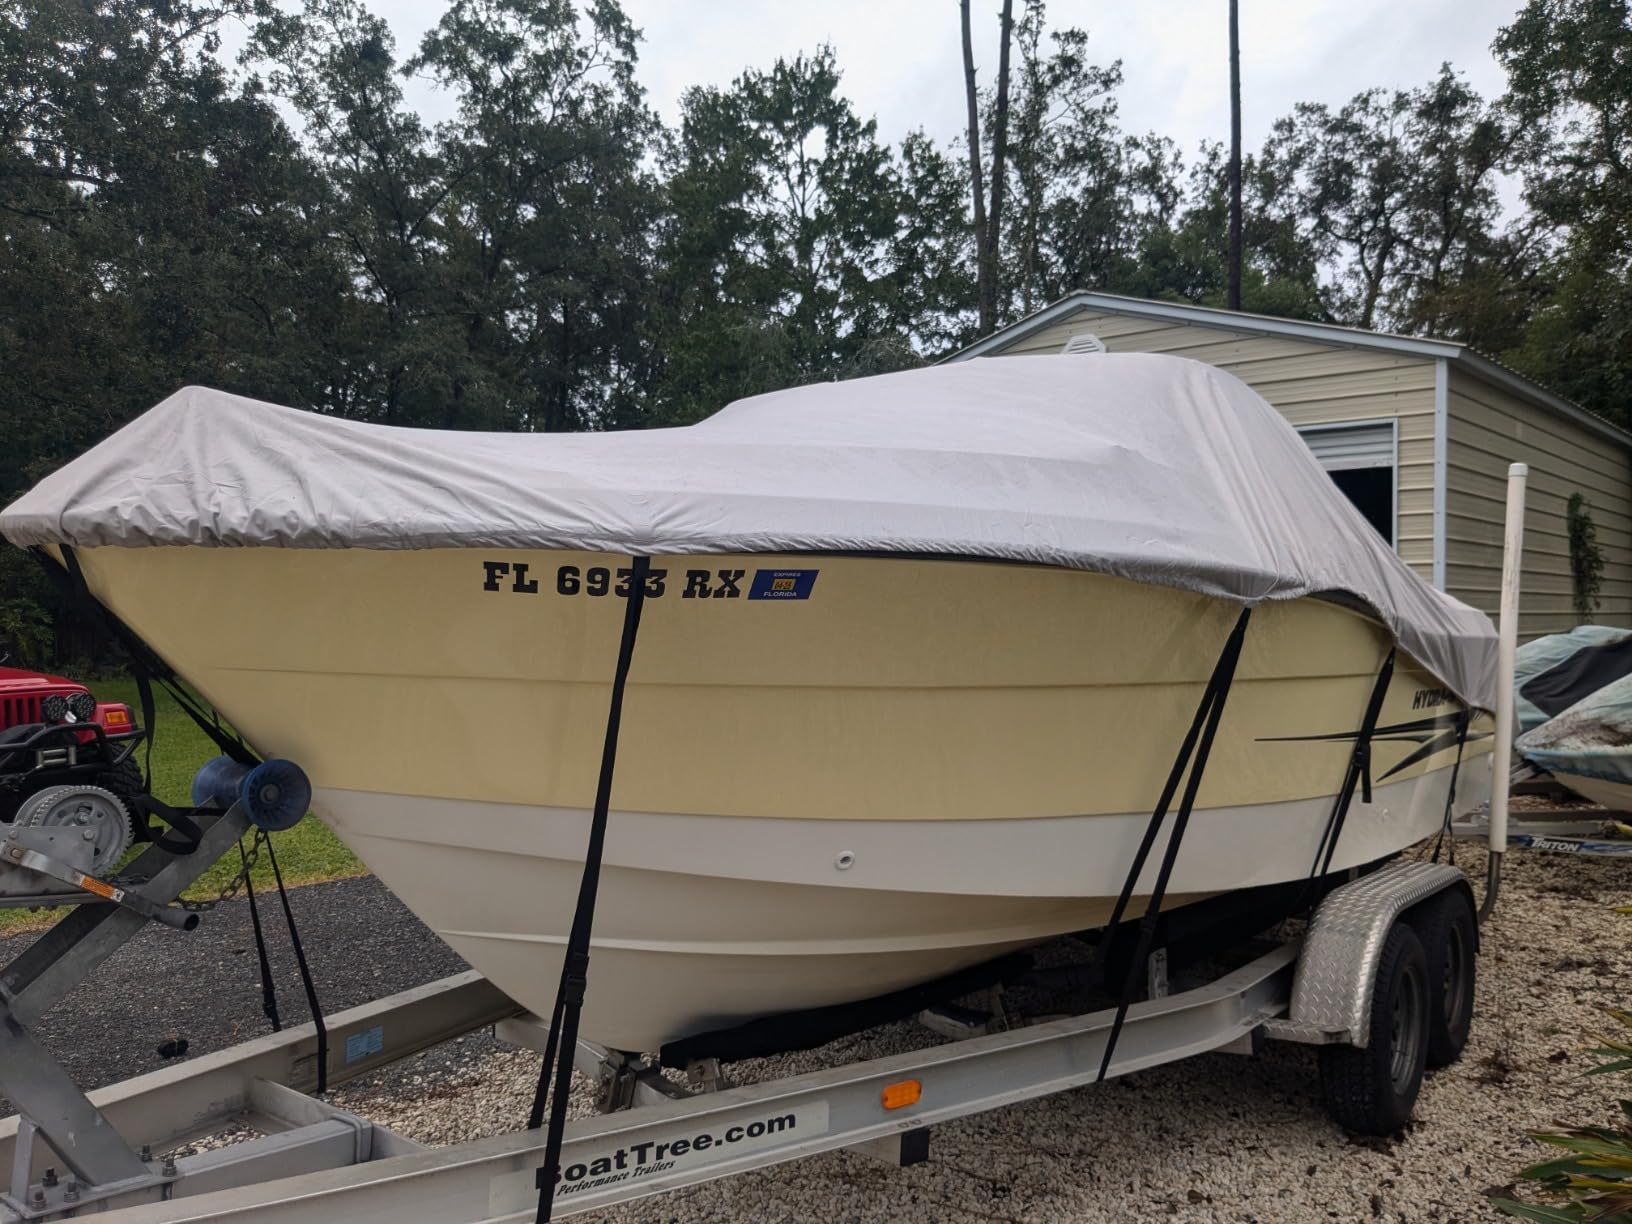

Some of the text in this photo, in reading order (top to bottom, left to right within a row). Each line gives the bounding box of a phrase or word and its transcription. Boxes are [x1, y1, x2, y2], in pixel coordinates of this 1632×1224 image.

[483, 561, 745, 599] FL 6933 RX
[1531, 836, 1580, 852] TRITON
[556, 1159, 676, 1197] Performance Trailers
